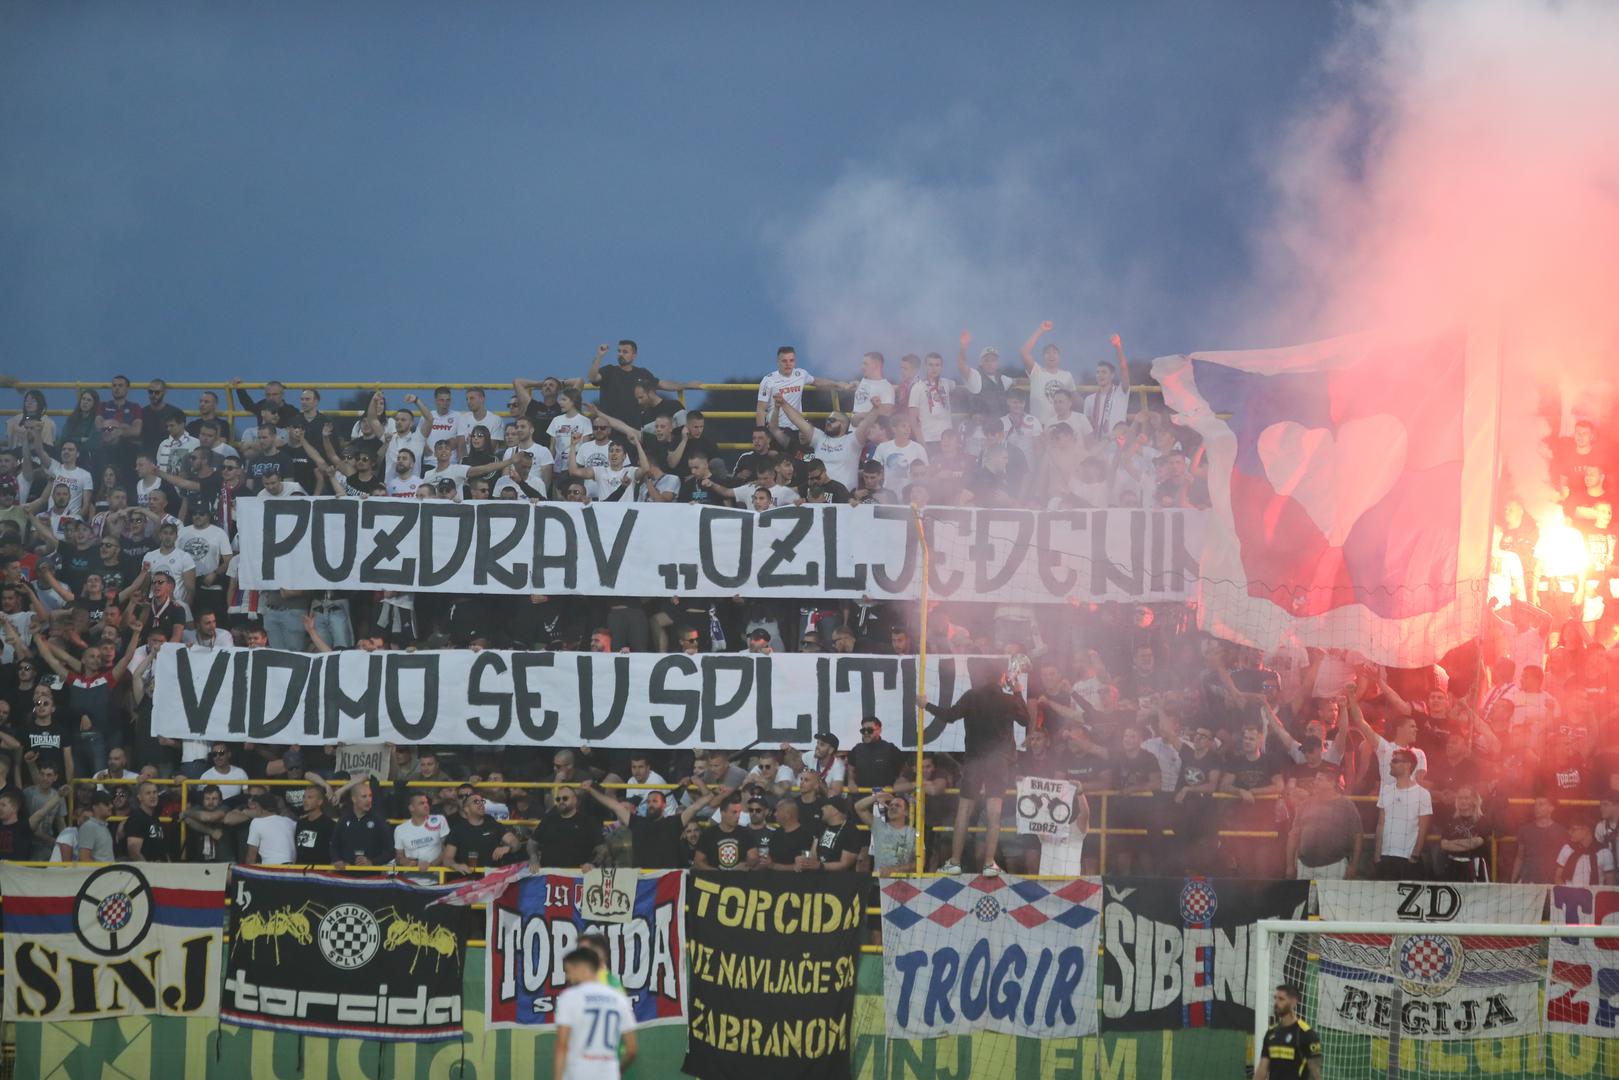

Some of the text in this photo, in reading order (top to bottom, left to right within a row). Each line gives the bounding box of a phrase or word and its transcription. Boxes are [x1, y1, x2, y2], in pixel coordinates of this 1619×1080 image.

[262, 500, 638, 589] POZDRAV
[176, 647, 439, 740] VIDIMO
[466, 652, 559, 742] SE
[577, 656, 630, 740] U
[340, 751, 383, 772] KLOŠARI
[1031, 780, 1063, 793] BRATE
[326, 907, 374, 928] HAJDUK
[694, 876, 861, 934] TORCIDA
[1397, 882, 1462, 922] ZD
[14, 935, 212, 1017] SINJ
[328, 950, 366, 966] SPLIT
[497, 902, 677, 1000] TORIDA
[717, 951, 832, 994] NAVIJAČE
[834, 953, 855, 993] SA
[224, 969, 462, 1025] torcida
[895, 938, 1084, 1028] TROGIR
[1336, 984, 1518, 1036] REGIJA
[584, 1008, 621, 1050] 70
[691, 997, 847, 1059] ZABRANOM
